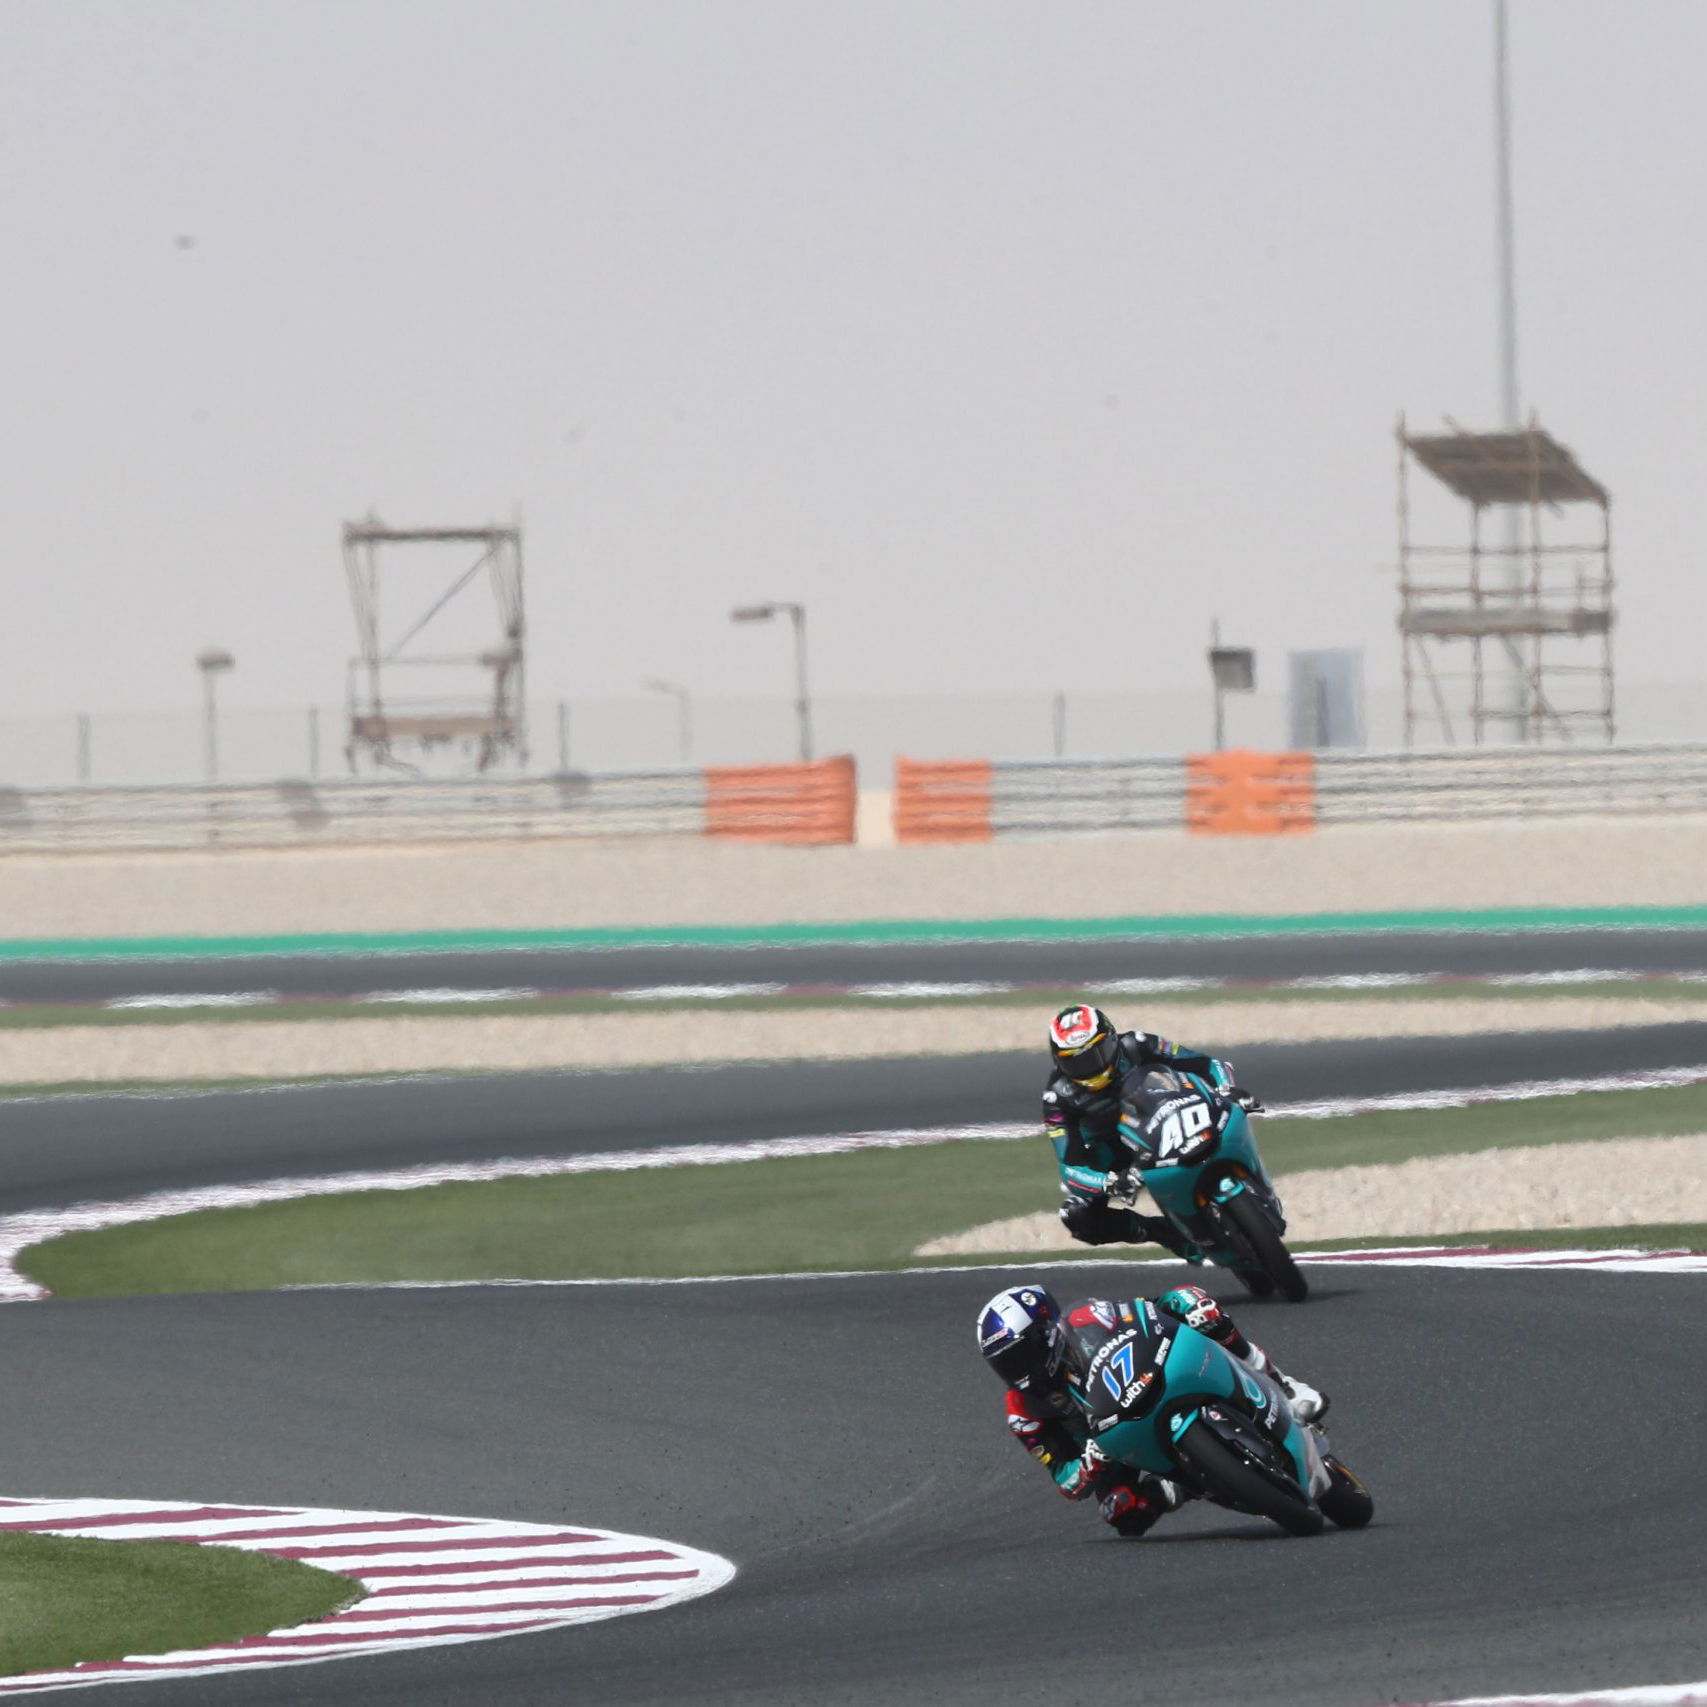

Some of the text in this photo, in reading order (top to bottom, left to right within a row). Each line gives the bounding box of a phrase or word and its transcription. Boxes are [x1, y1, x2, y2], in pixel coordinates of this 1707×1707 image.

[1159, 1102, 1212, 1158] 40
[1085, 1328, 1137, 1392] PETRONAS
[1102, 1341, 1134, 1402] 17
